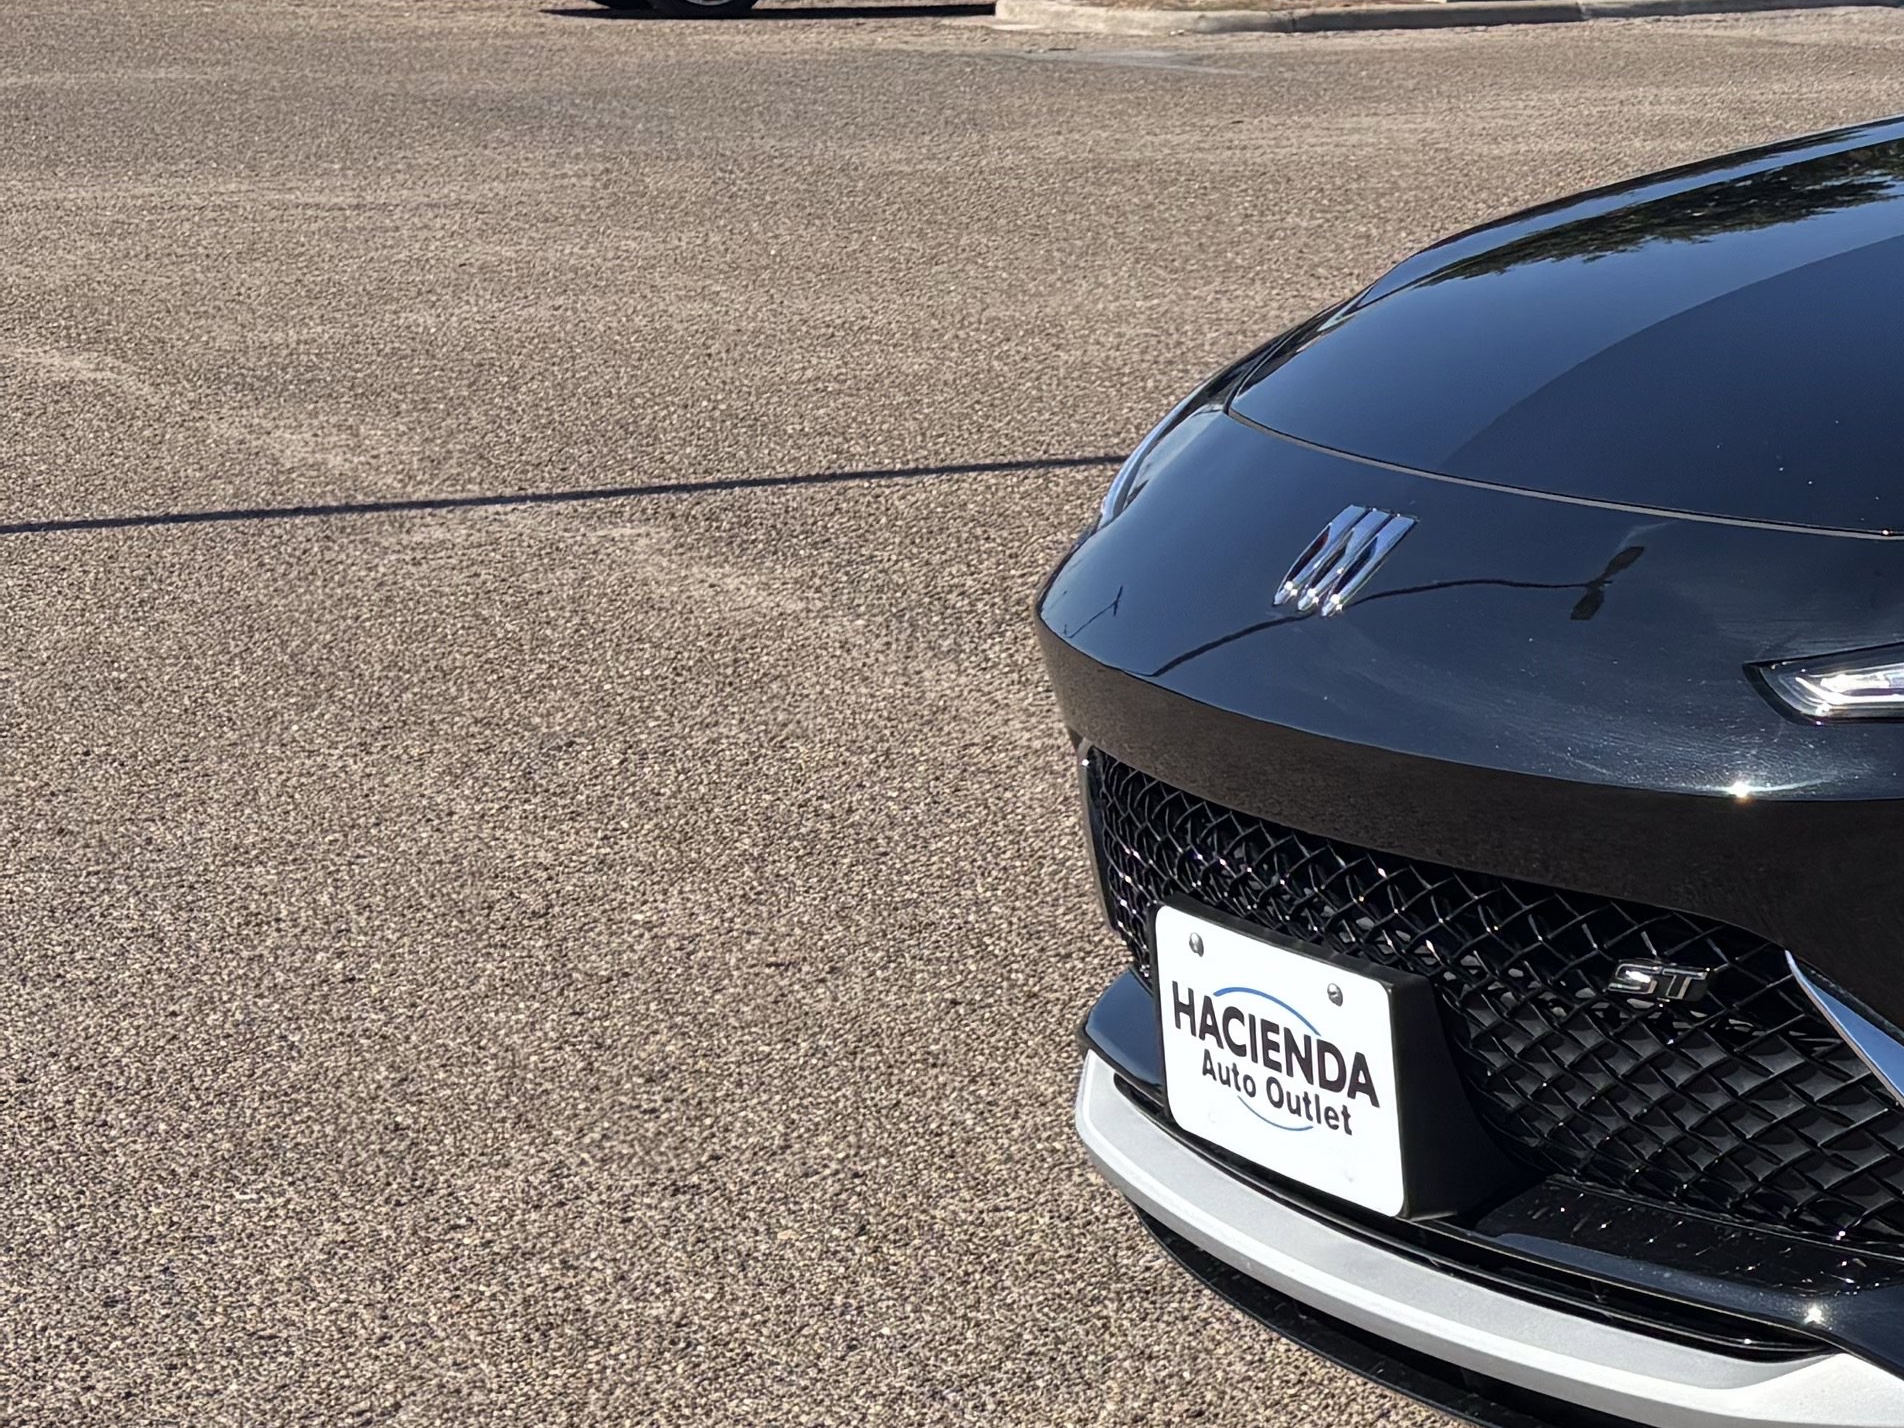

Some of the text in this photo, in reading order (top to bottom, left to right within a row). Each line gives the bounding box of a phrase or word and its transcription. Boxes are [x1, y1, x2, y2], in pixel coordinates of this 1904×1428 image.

[1607, 958, 1710, 1001] ST
[1171, 979, 1381, 1109] HACIENDA
[1201, 1048, 1353, 1136] Auto Outlet
